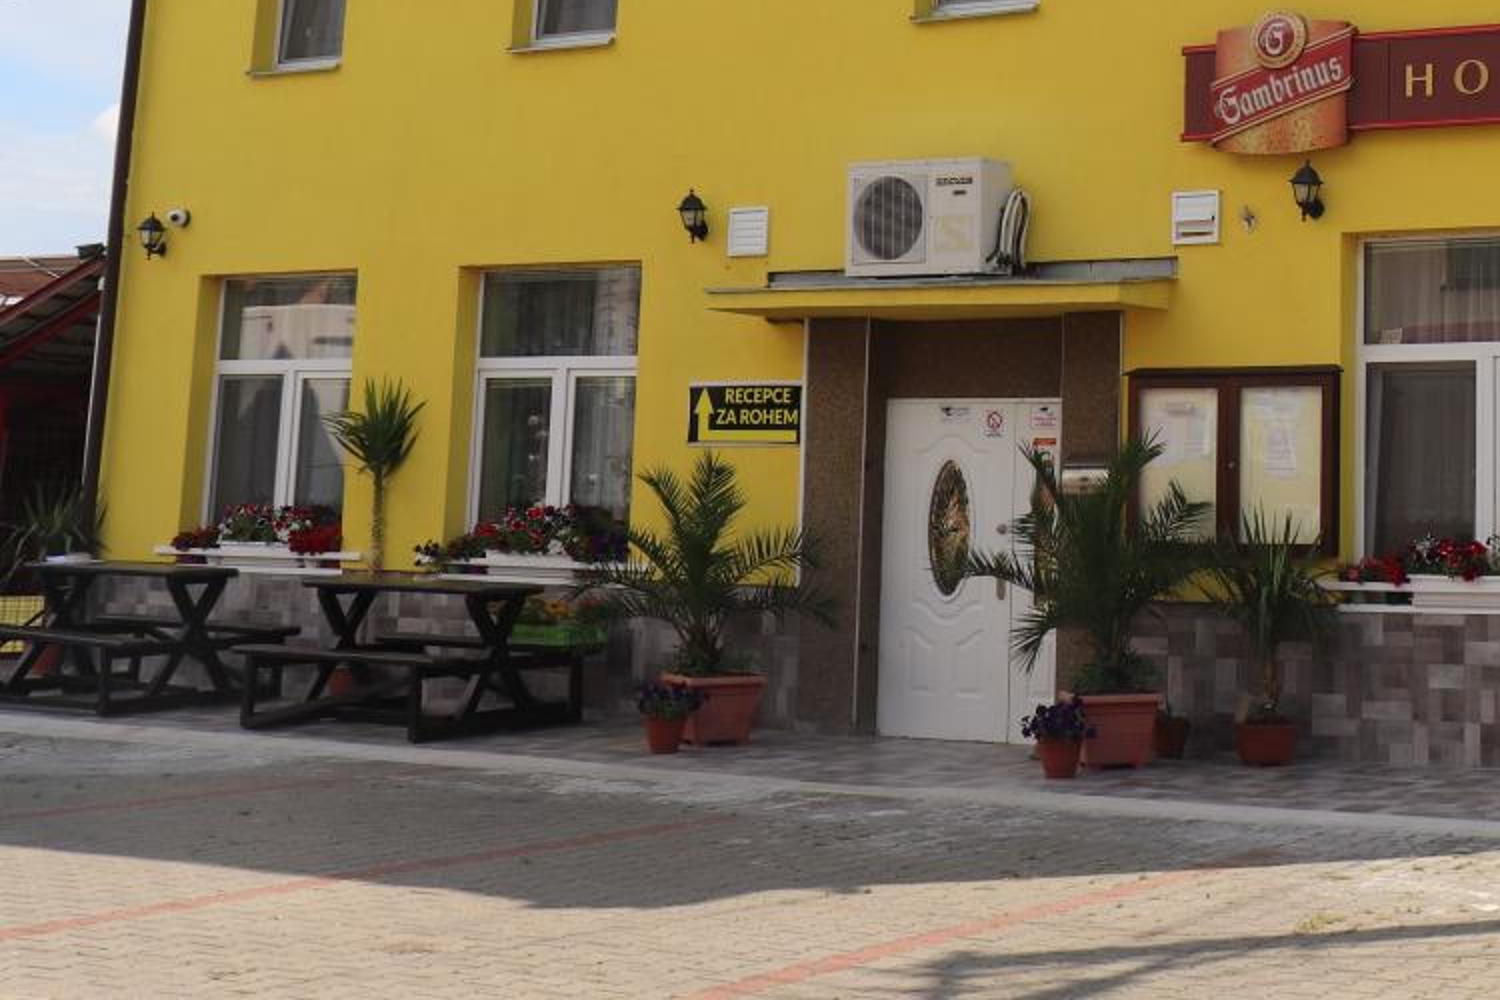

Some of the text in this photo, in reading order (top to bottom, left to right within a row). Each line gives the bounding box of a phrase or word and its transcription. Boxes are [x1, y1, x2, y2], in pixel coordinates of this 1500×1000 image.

[1214, 57, 1343, 124] Gambrinus
[725, 387, 792, 404] RECEPCE
[716, 408, 798, 425] ZA ROHEM
